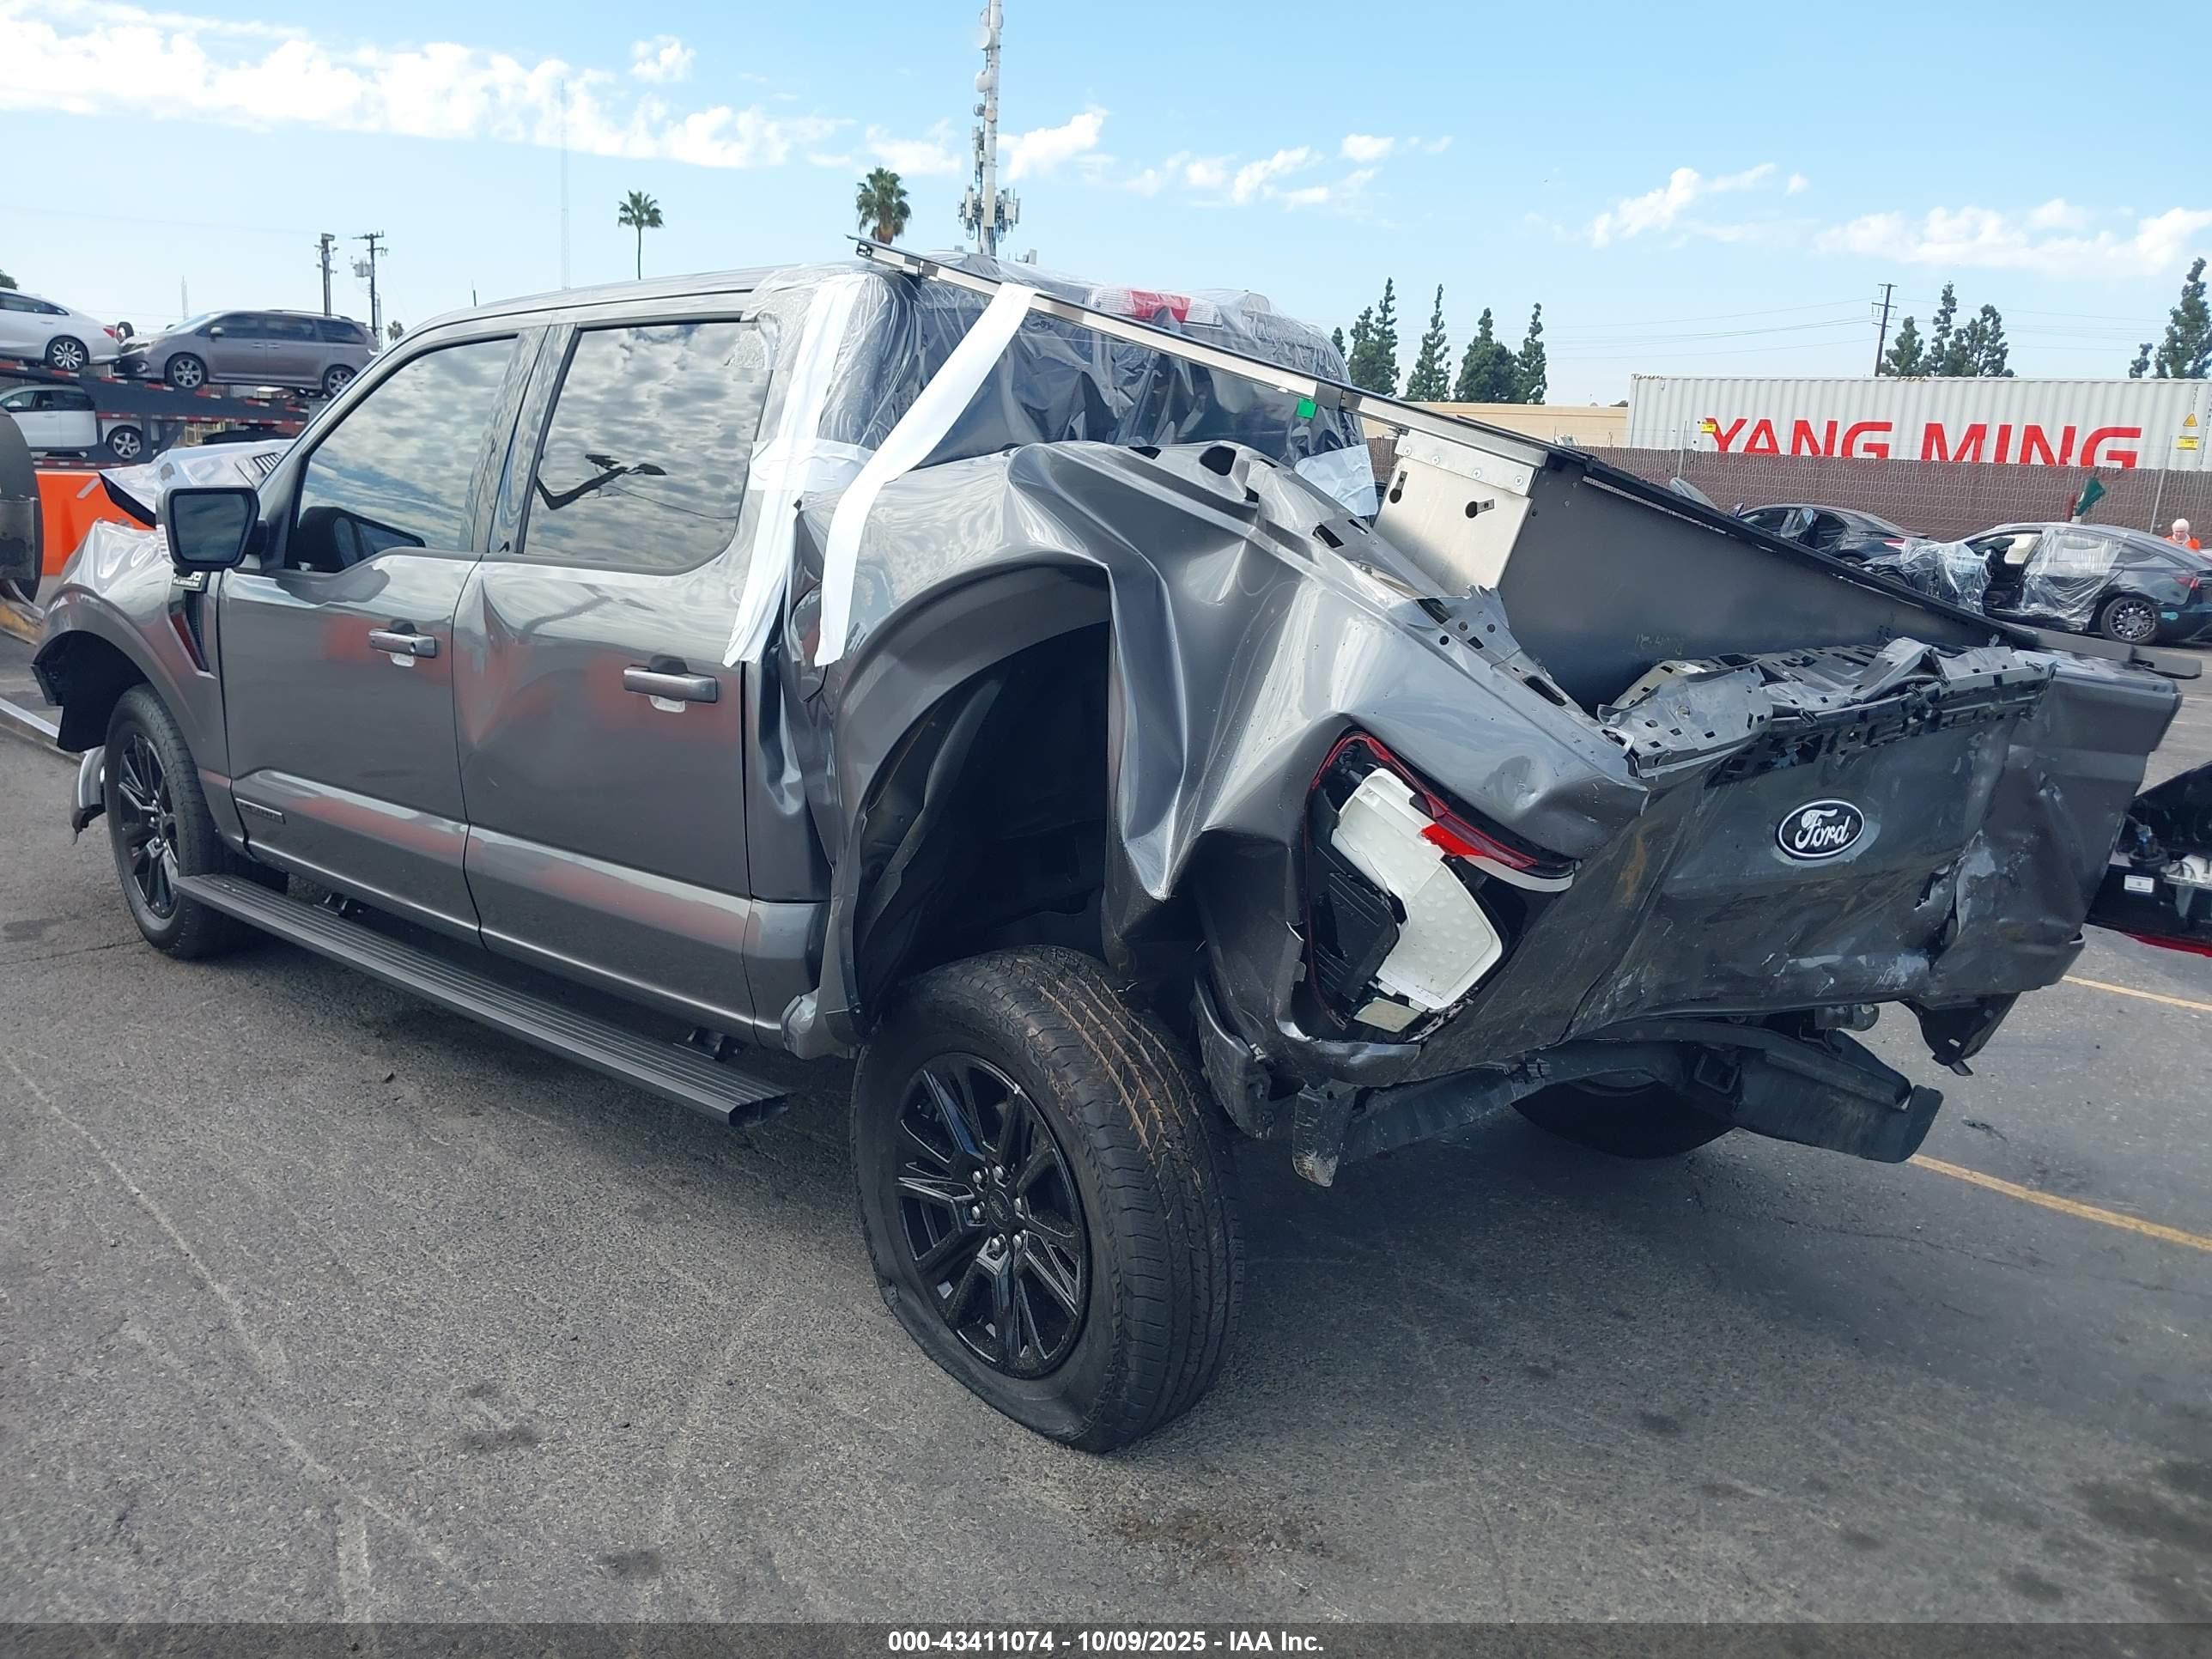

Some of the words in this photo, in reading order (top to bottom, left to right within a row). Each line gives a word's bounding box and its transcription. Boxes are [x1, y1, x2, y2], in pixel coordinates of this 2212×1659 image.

[1705, 417, 1893, 459] YANG
[1920, 422, 2142, 470] MING
[1794, 808, 1851, 850] Ford
